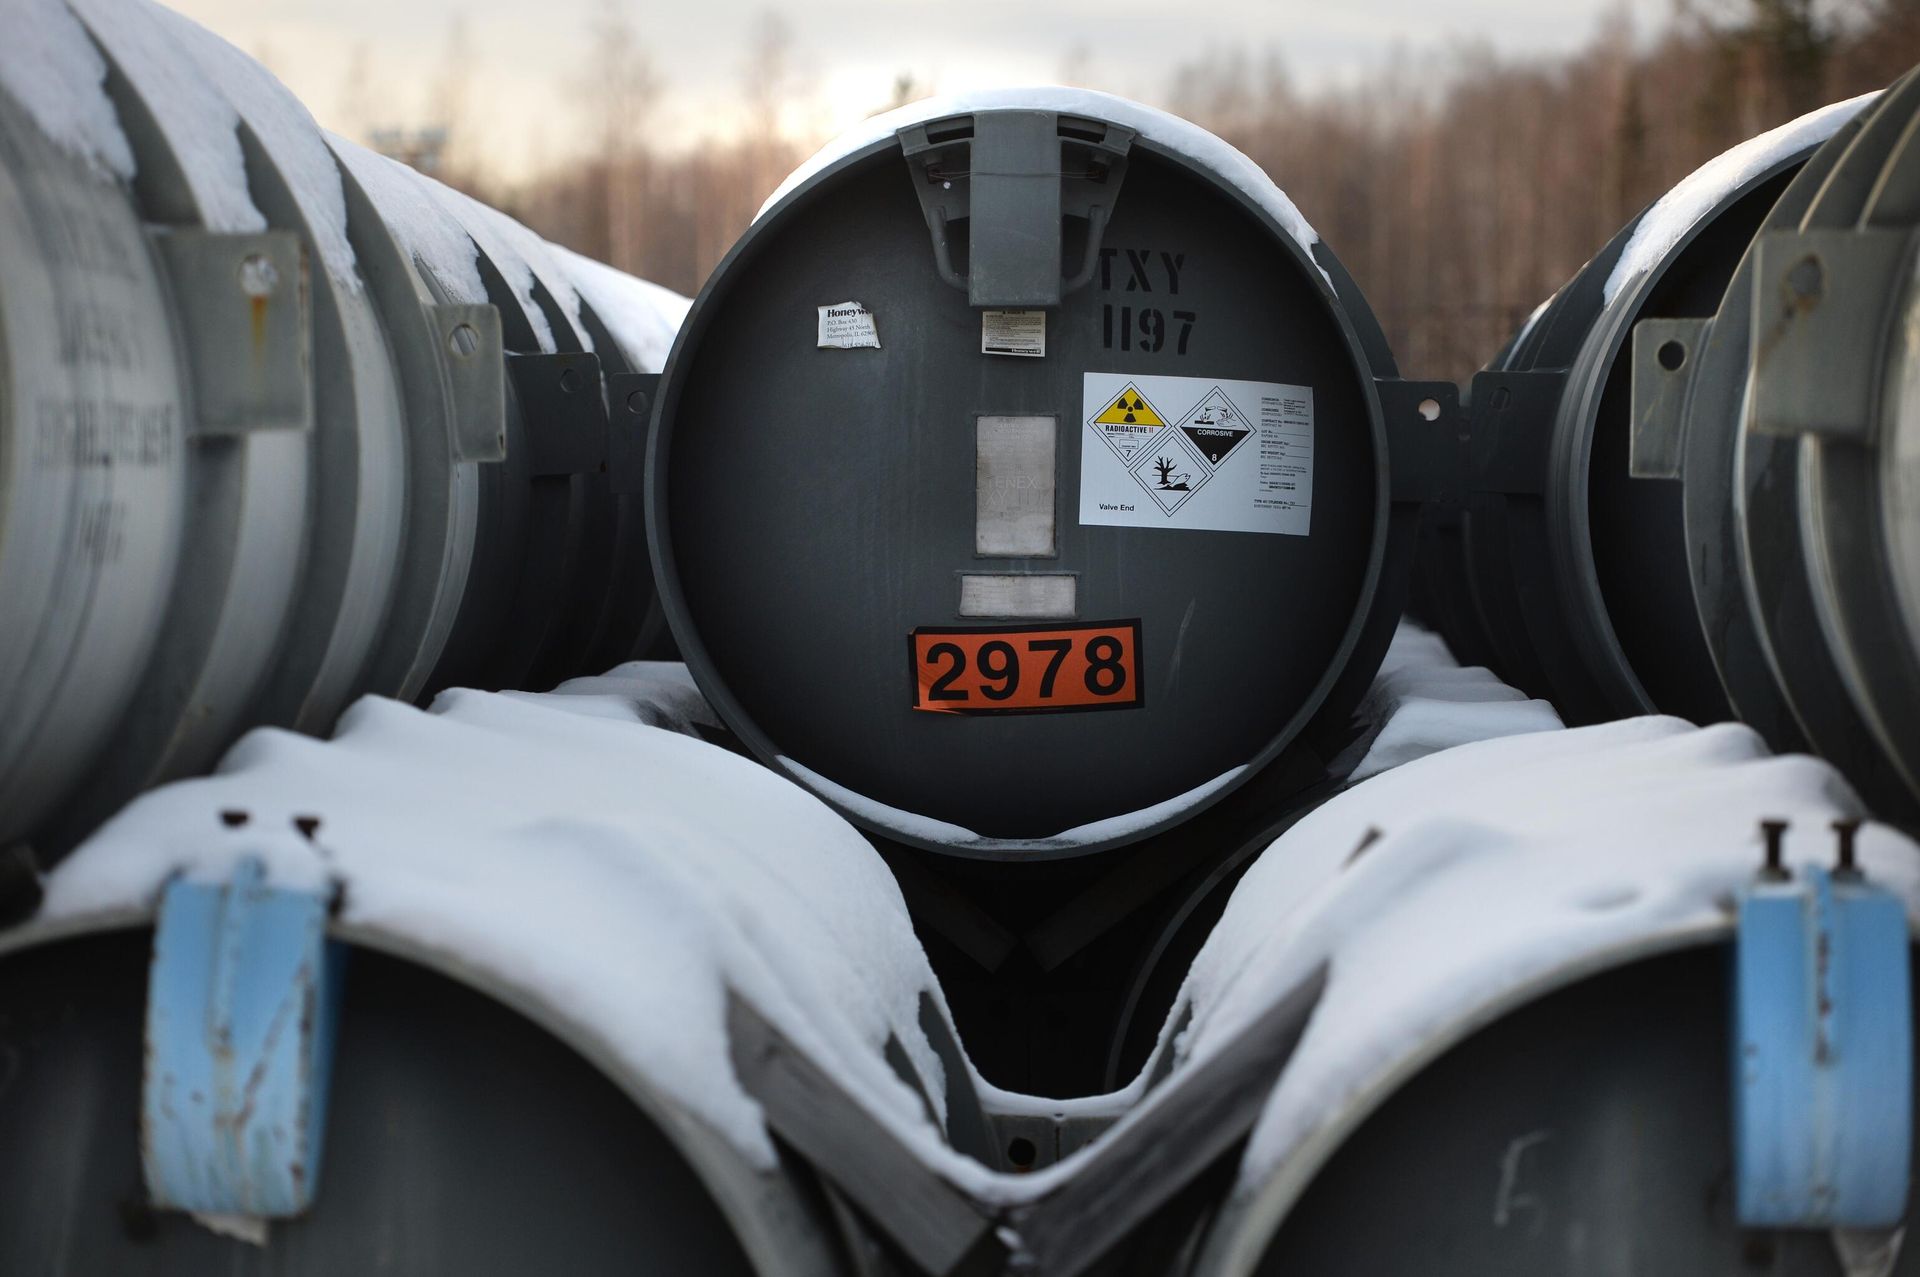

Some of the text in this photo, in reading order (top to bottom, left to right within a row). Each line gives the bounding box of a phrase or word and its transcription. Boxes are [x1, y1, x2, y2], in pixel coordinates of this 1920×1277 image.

[1099, 248, 1185, 295] TXY
[1103, 304, 1197, 356] 1197
[1105, 425, 1147, 434] RADIOACTIVE
[1197, 429, 1234, 437] CORROSIVE
[1211, 453, 1218, 462] 8
[1099, 503, 1118, 511] Valve
[926, 635, 1127, 701] 2978
